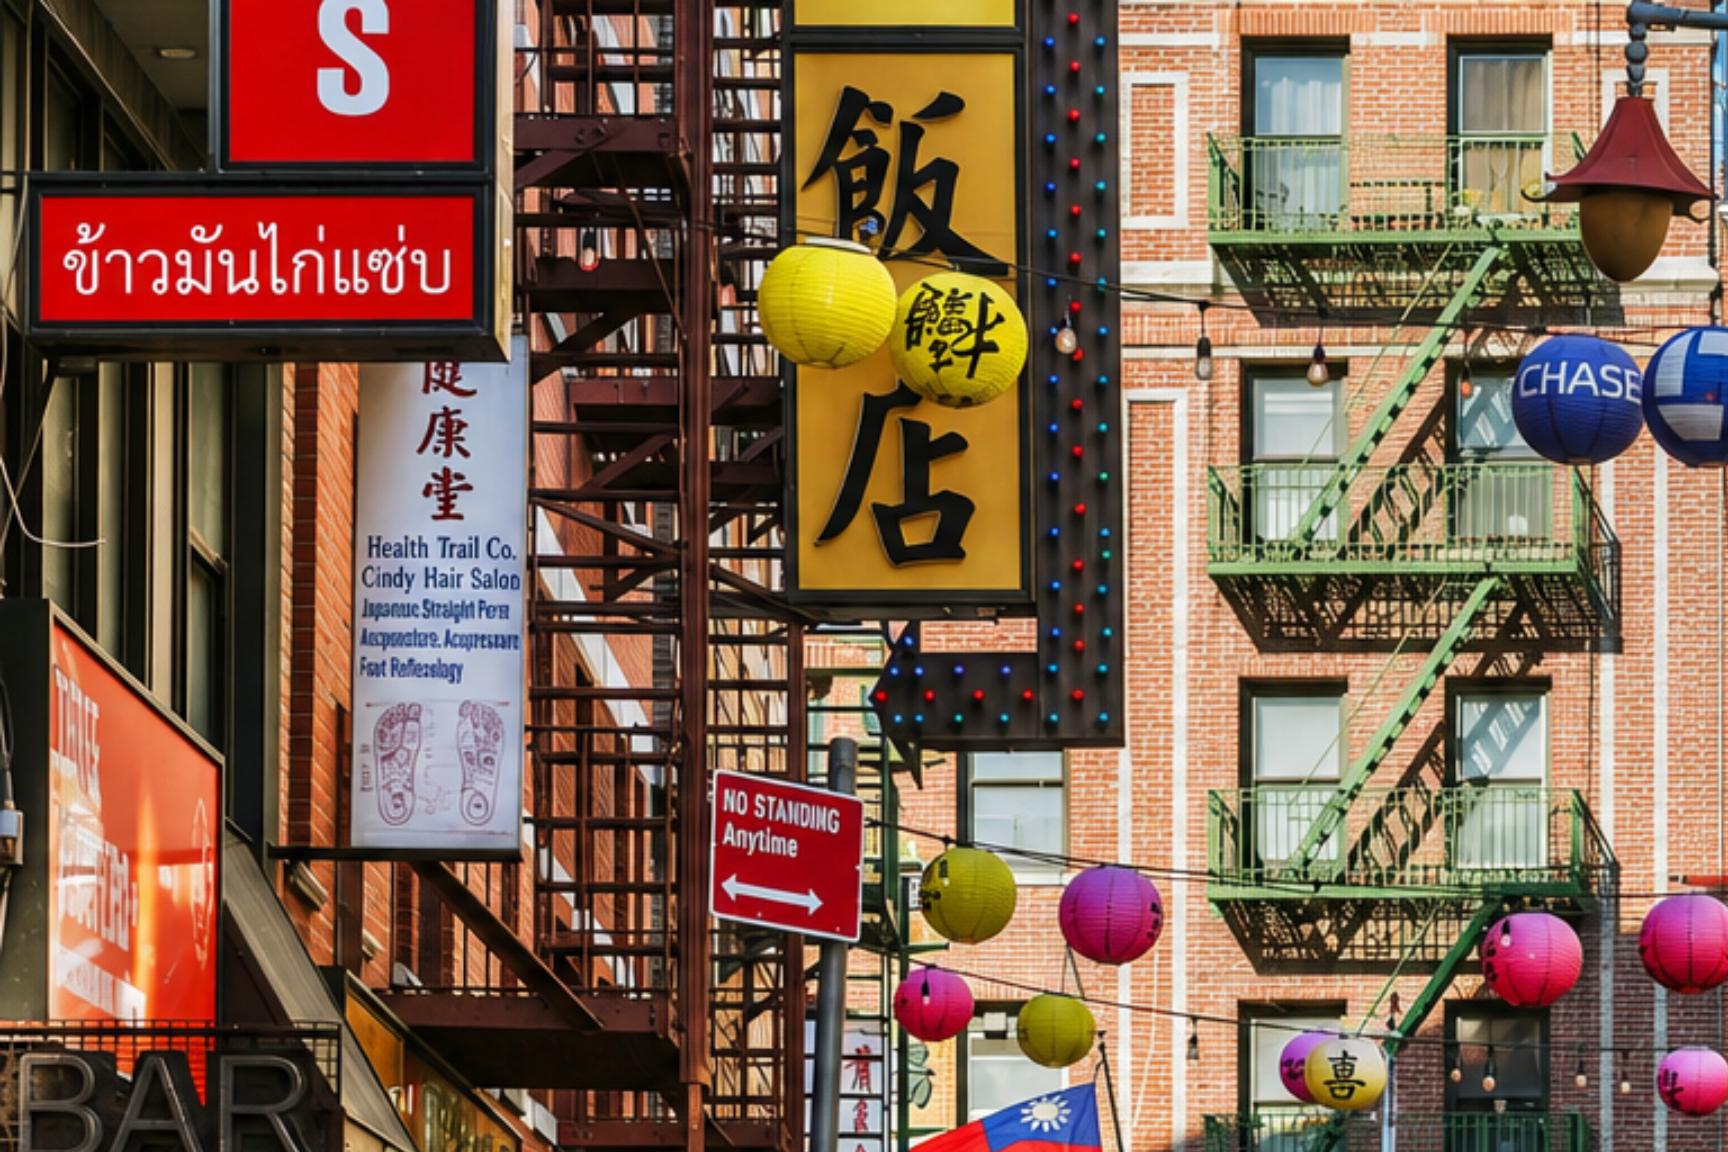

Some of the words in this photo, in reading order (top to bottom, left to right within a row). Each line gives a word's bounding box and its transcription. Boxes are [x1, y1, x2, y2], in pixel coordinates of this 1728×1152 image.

[316, 0, 391, 116] S
[63, 222, 452, 296] ข้าวมันไก่แซ่บ
[802, 85, 1009, 567] 飯店
[1519, 361, 1641, 404] CHASE
[367, 535, 429, 559] Health
[437, 536, 480, 559] Trail
[486, 536, 517, 560] Co.
[361, 565, 415, 594] Cindy
[424, 566, 464, 589] Hair
[470, 567, 521, 590] Salon
[723, 787, 749, 817] NO
[753, 791, 841, 835] STANDING
[722, 820, 799, 859] Anytime
